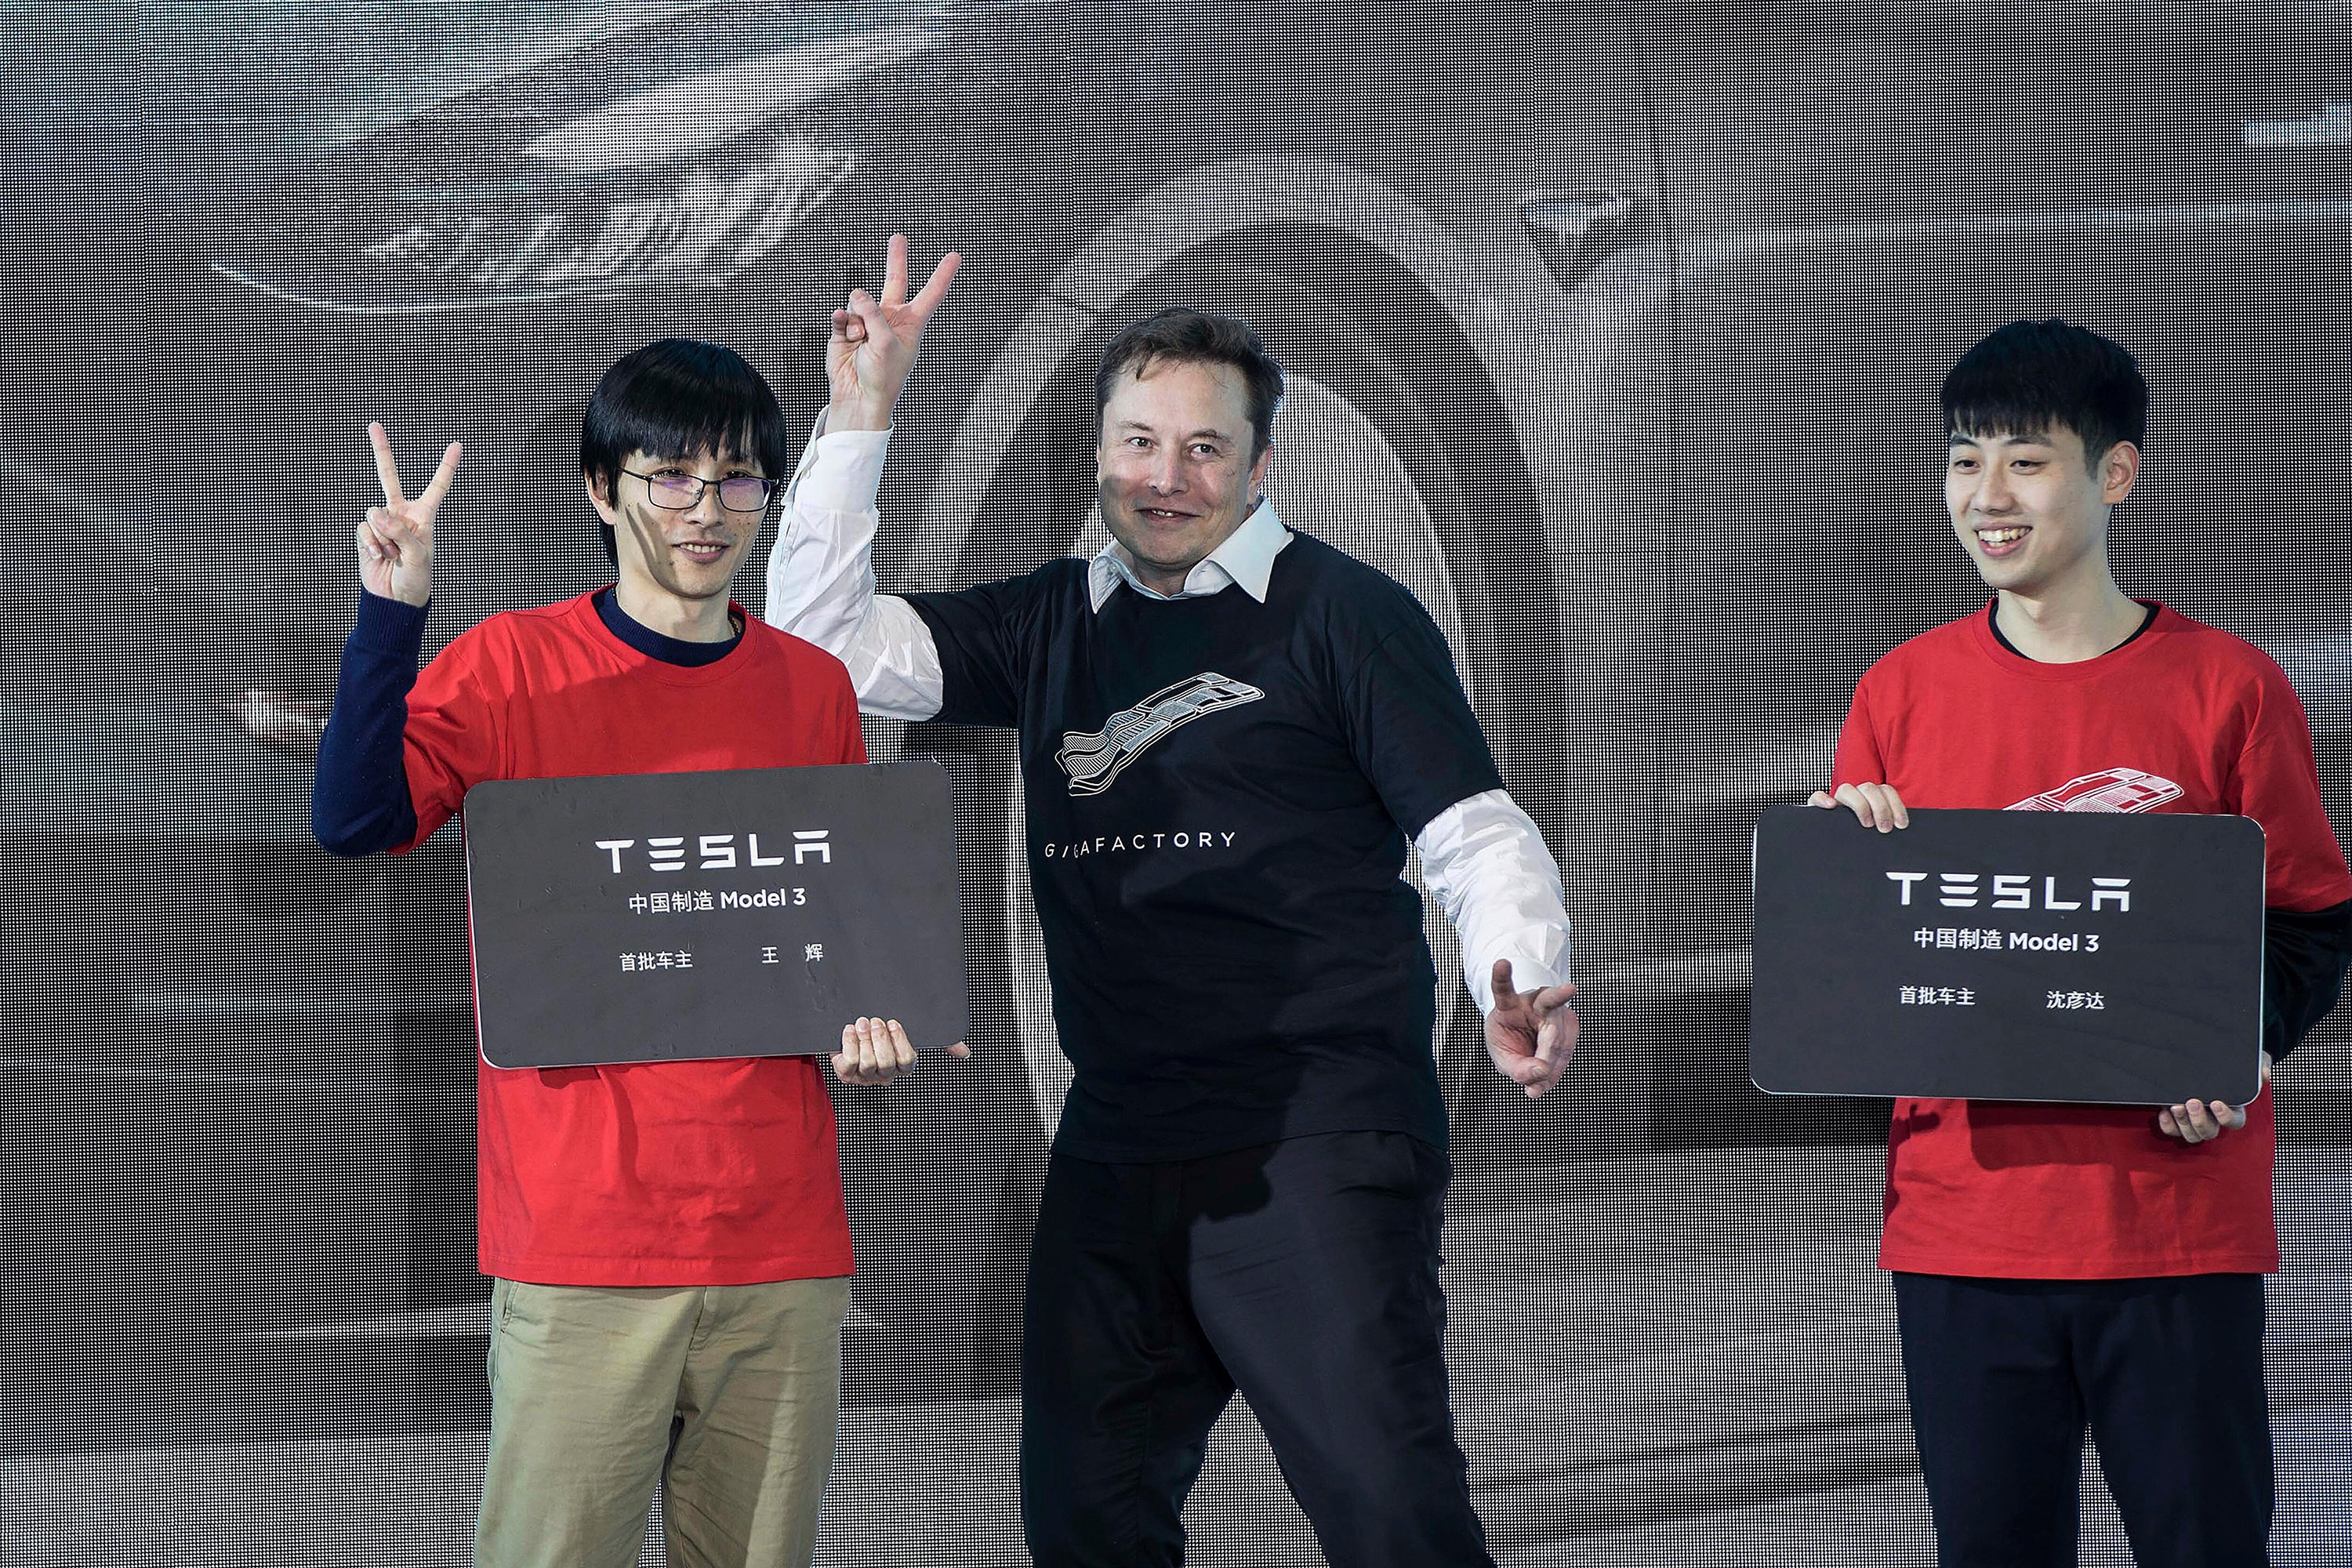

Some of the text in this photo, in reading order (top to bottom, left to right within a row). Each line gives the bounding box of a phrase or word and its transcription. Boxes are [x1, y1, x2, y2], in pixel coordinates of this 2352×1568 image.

[594, 829, 831, 873] TESLA
[629, 887, 807, 915] 中国制造 Model 3
[1886, 872, 2131, 912] TESLA
[1914, 927, 2100, 953] 中国制造 Model 3
[619, 949, 694, 973] 首批车主
[1899, 985, 2106, 1011] 首批车主 沈彦达
